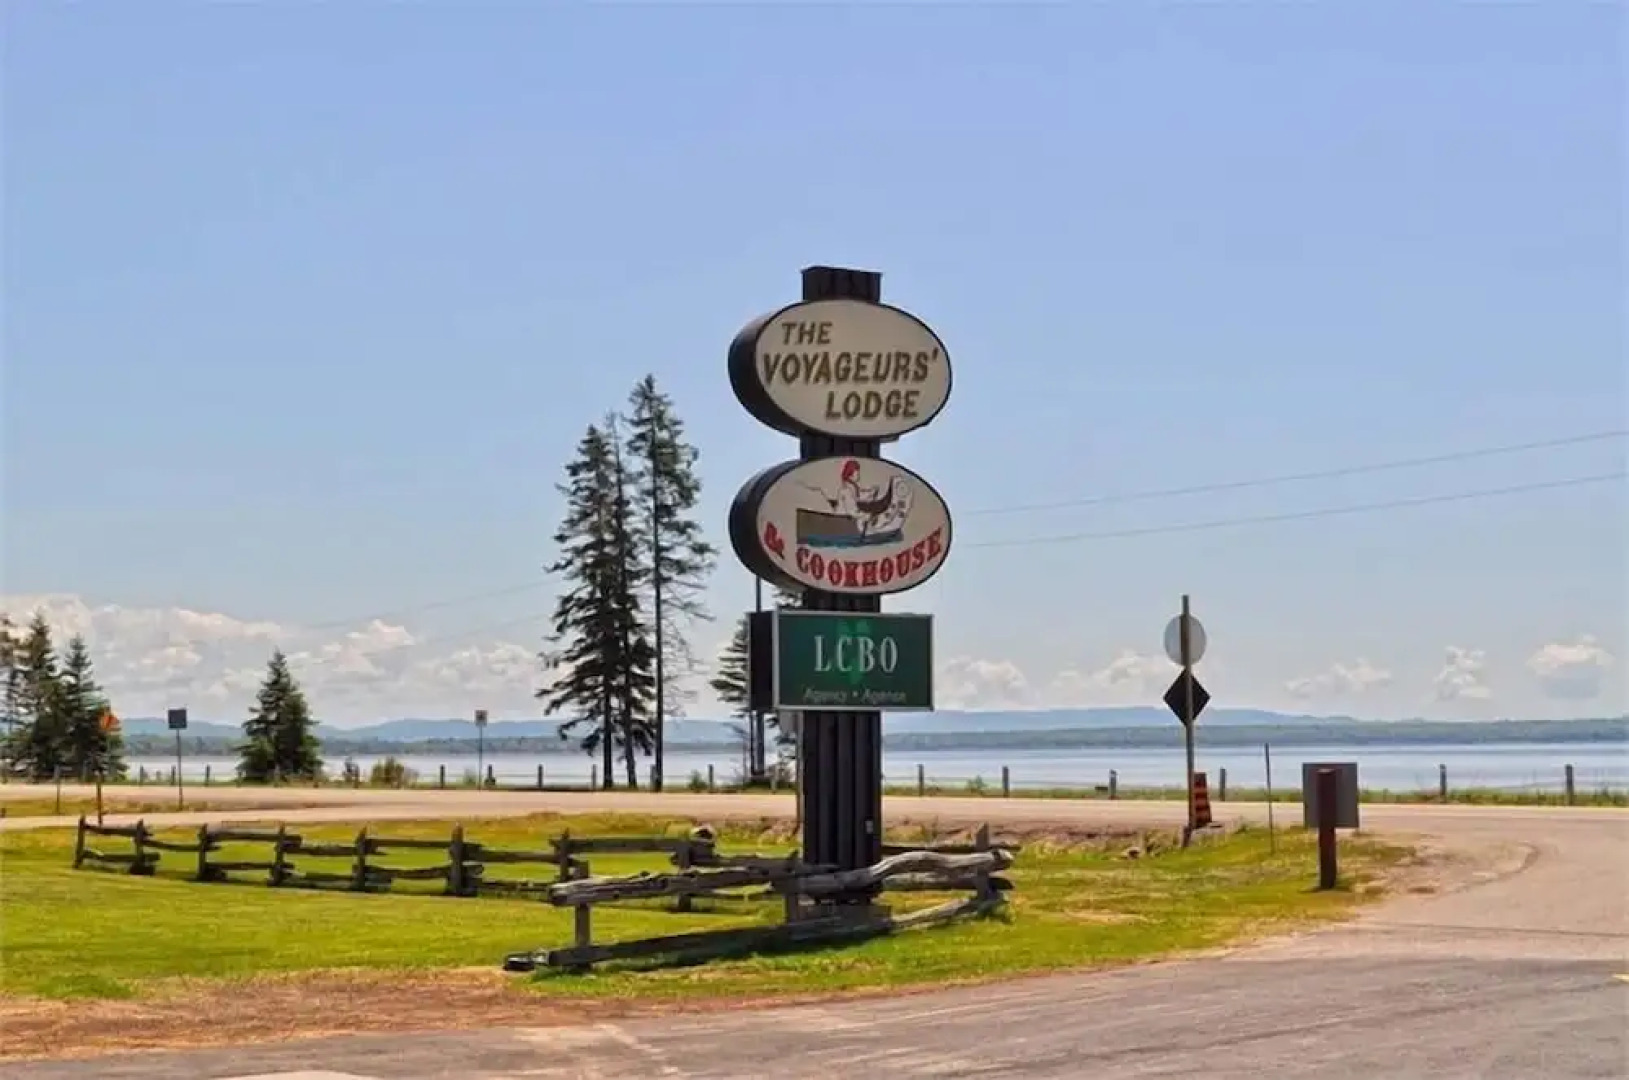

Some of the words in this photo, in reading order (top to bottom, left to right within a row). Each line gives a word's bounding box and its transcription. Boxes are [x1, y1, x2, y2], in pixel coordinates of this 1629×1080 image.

[782, 322, 832, 344] THE
[763, 348, 938, 384] VOYAGEURS'
[826, 390, 920, 419] LODGE
[764, 521, 785, 559] &
[796, 527, 942, 587] COOKHOUSE
[814, 635, 898, 673] LCBO
